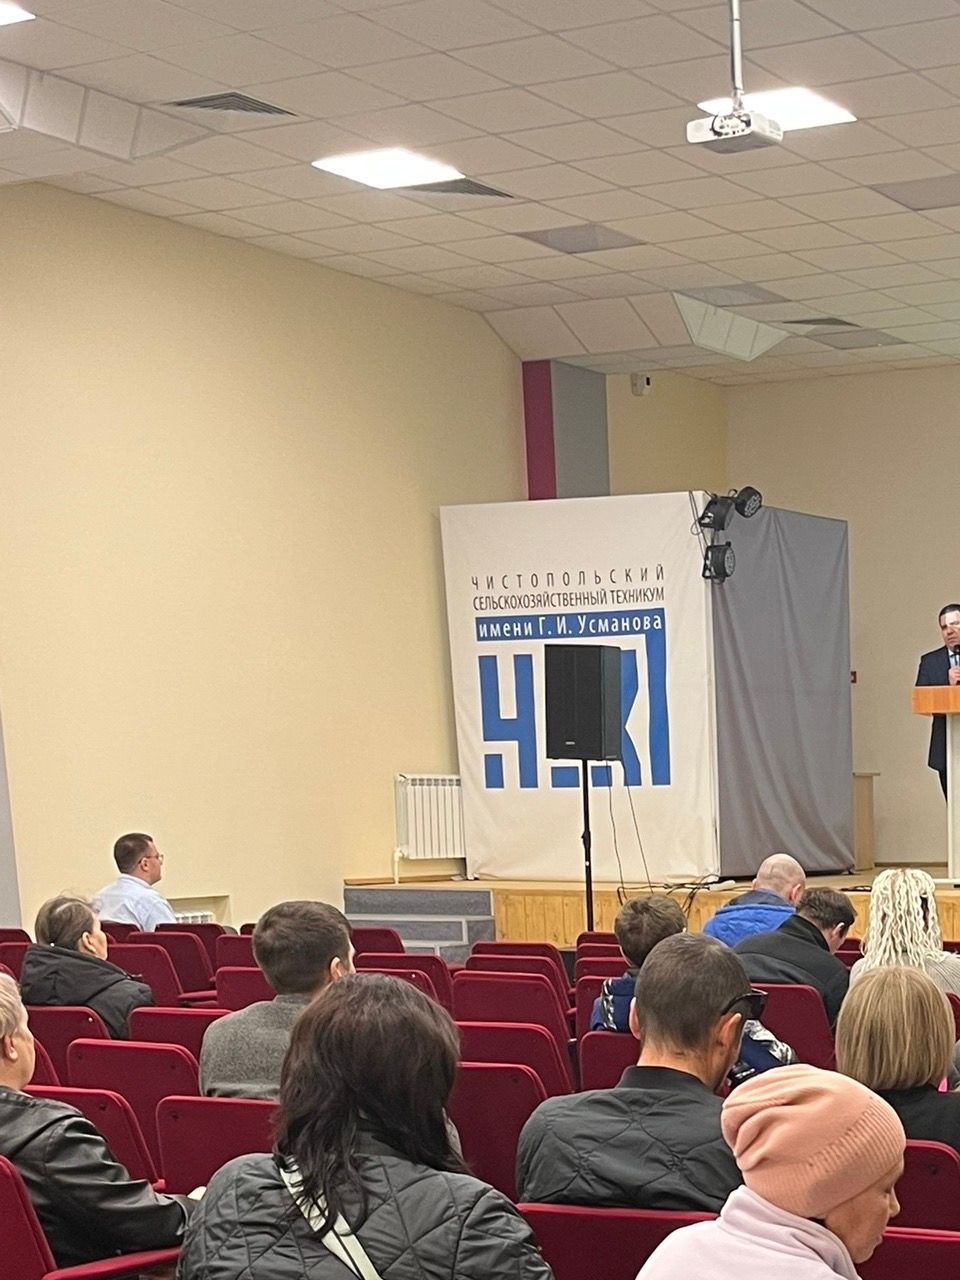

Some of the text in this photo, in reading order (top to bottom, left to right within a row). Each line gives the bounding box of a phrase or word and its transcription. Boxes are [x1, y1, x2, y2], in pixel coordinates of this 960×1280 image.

[471, 563, 665, 591] ЧИСТОПОЛЬСКИЙ
[473, 586, 665, 611] СЕЛЬСКОХОЗЯЙСТВЕННЫЙ ТЕХНИКУМ
[478, 614, 662, 639] имени Г. И. Усманова
